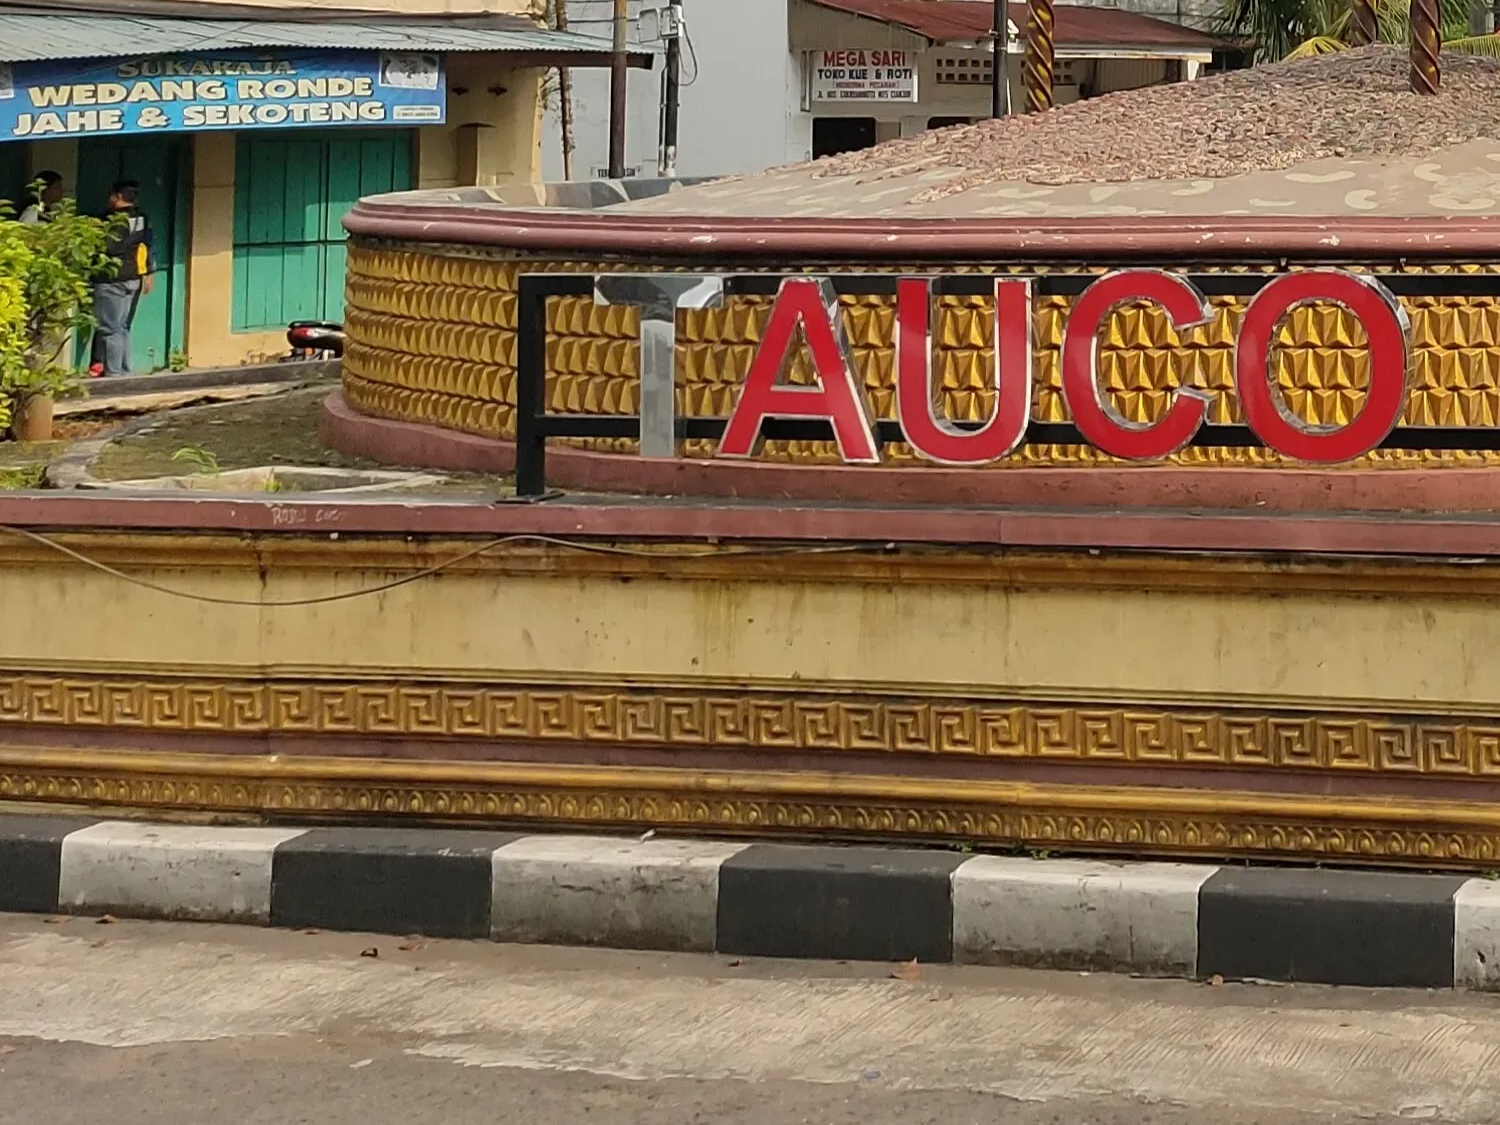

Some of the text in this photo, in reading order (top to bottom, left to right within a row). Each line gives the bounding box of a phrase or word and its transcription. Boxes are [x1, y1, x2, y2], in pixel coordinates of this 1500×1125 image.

[117, 57, 298, 77] SUKARAJA
[823, 50, 906, 67] MEGA SARI
[817, 68, 846, 80] TOKO
[848, 68, 868, 80] KUE
[28, 77, 374, 107] WEDANG RONDE
[12, 108, 124, 136] JAHE
[136, 106, 171, 128] &
[182, 101, 386, 126] SEKOTENG
